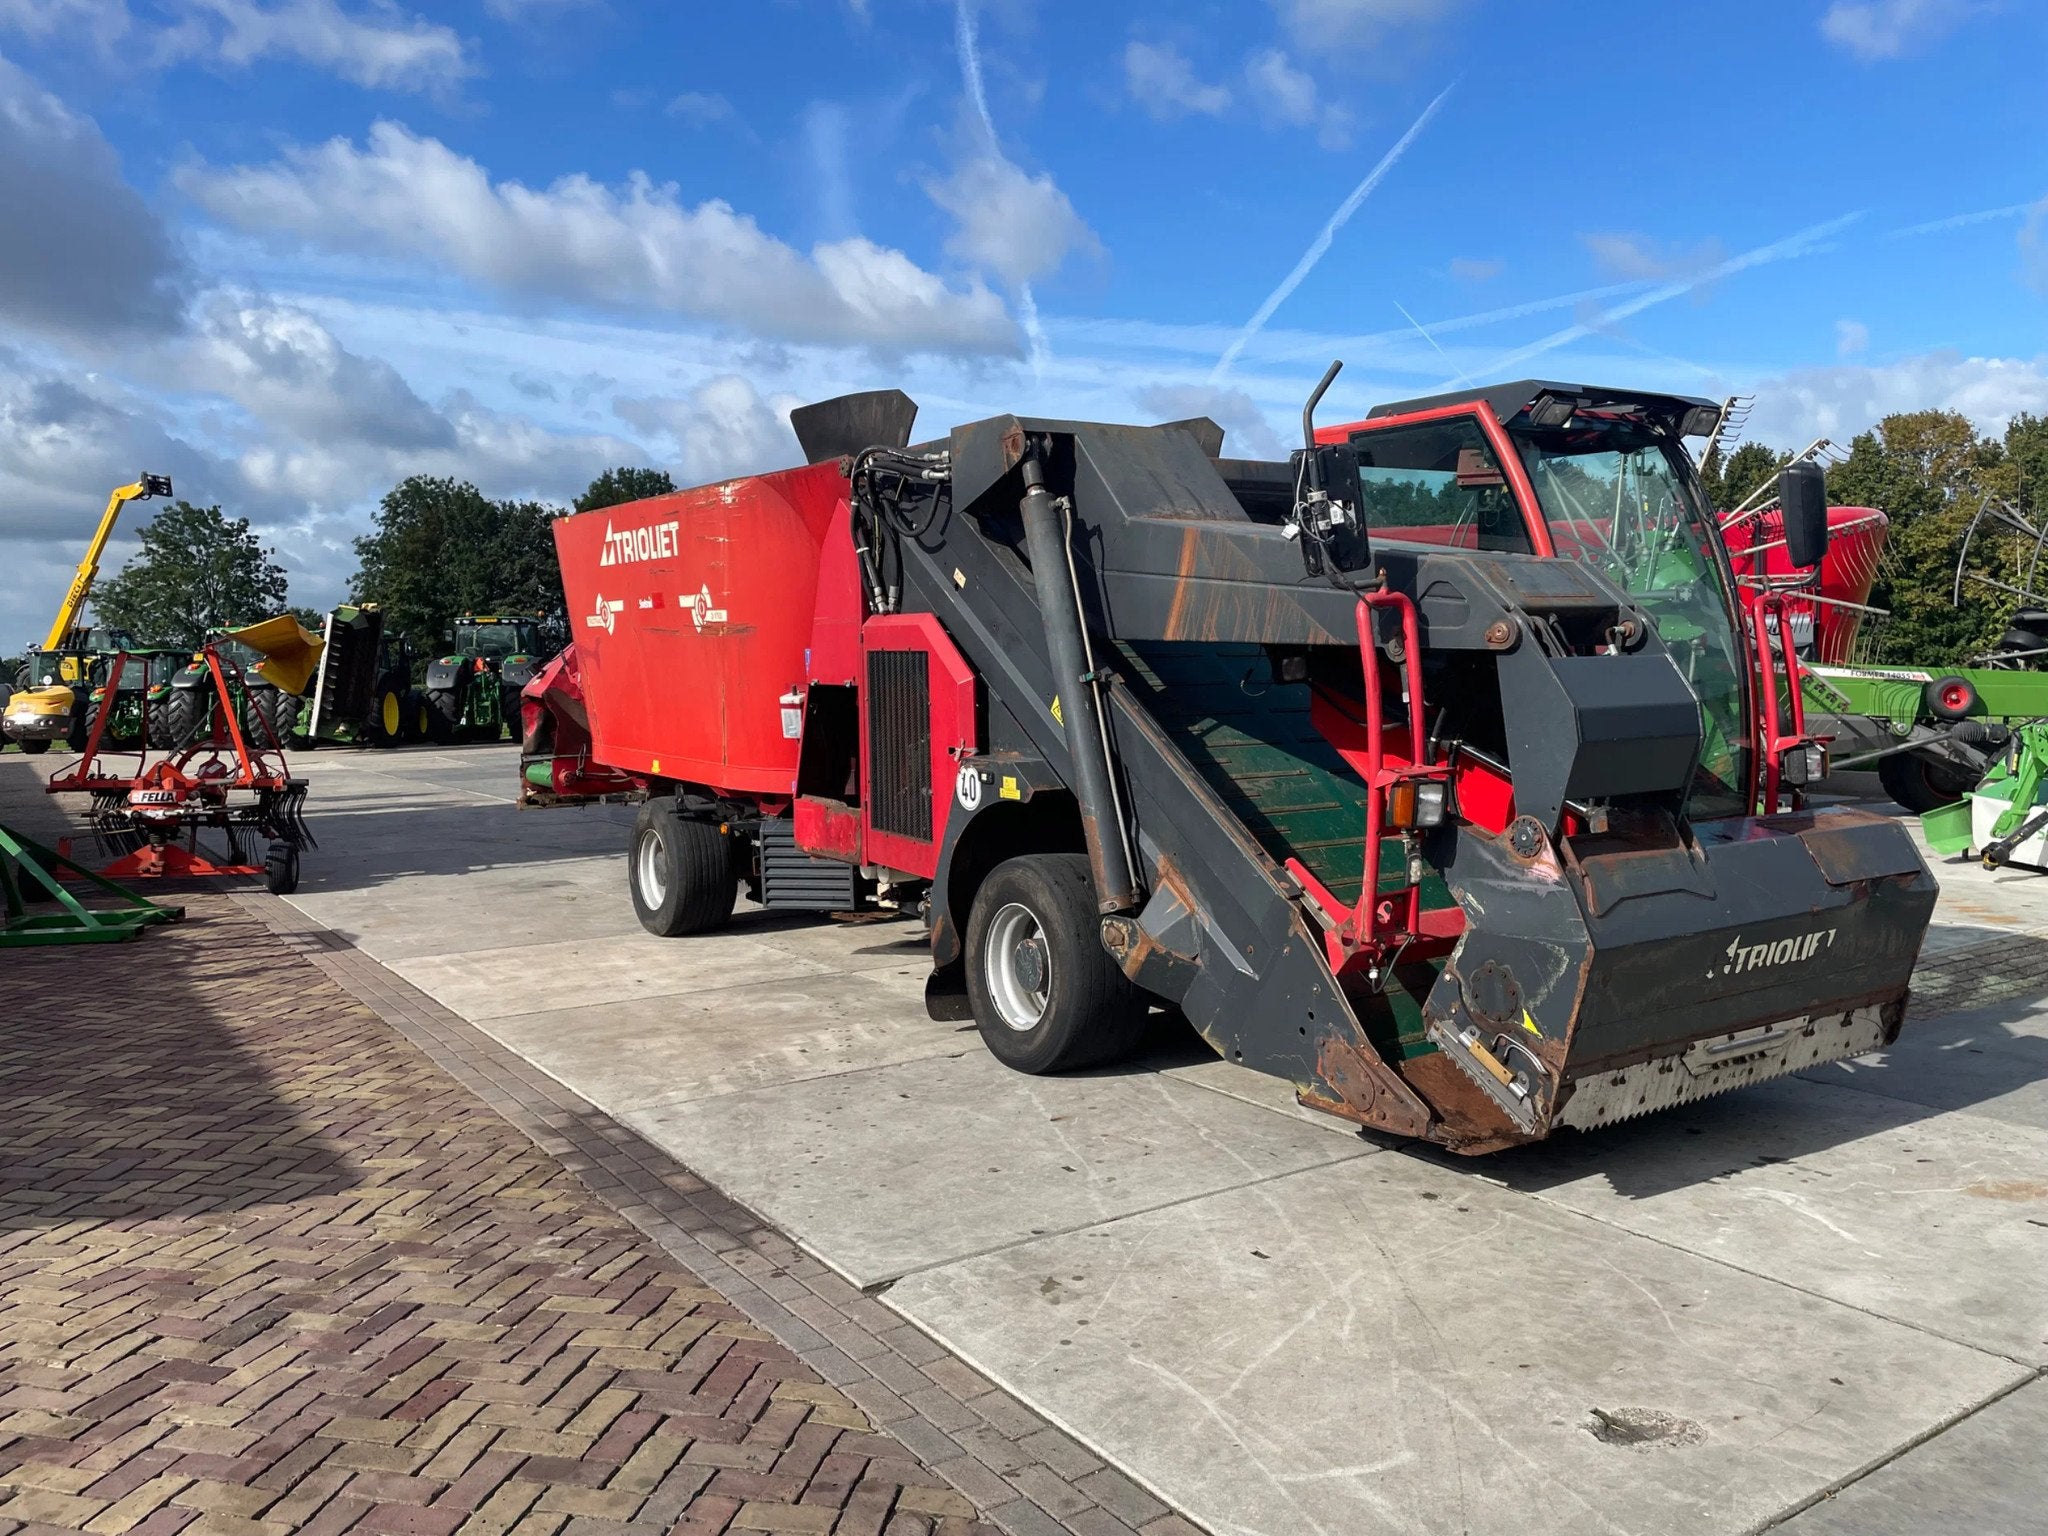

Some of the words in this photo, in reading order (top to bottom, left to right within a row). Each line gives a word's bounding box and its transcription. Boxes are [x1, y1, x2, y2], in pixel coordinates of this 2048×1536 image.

[613, 521, 679, 564] TRIOLIET
[141, 792, 175, 802] FELLA
[961, 773, 976, 801] 40
